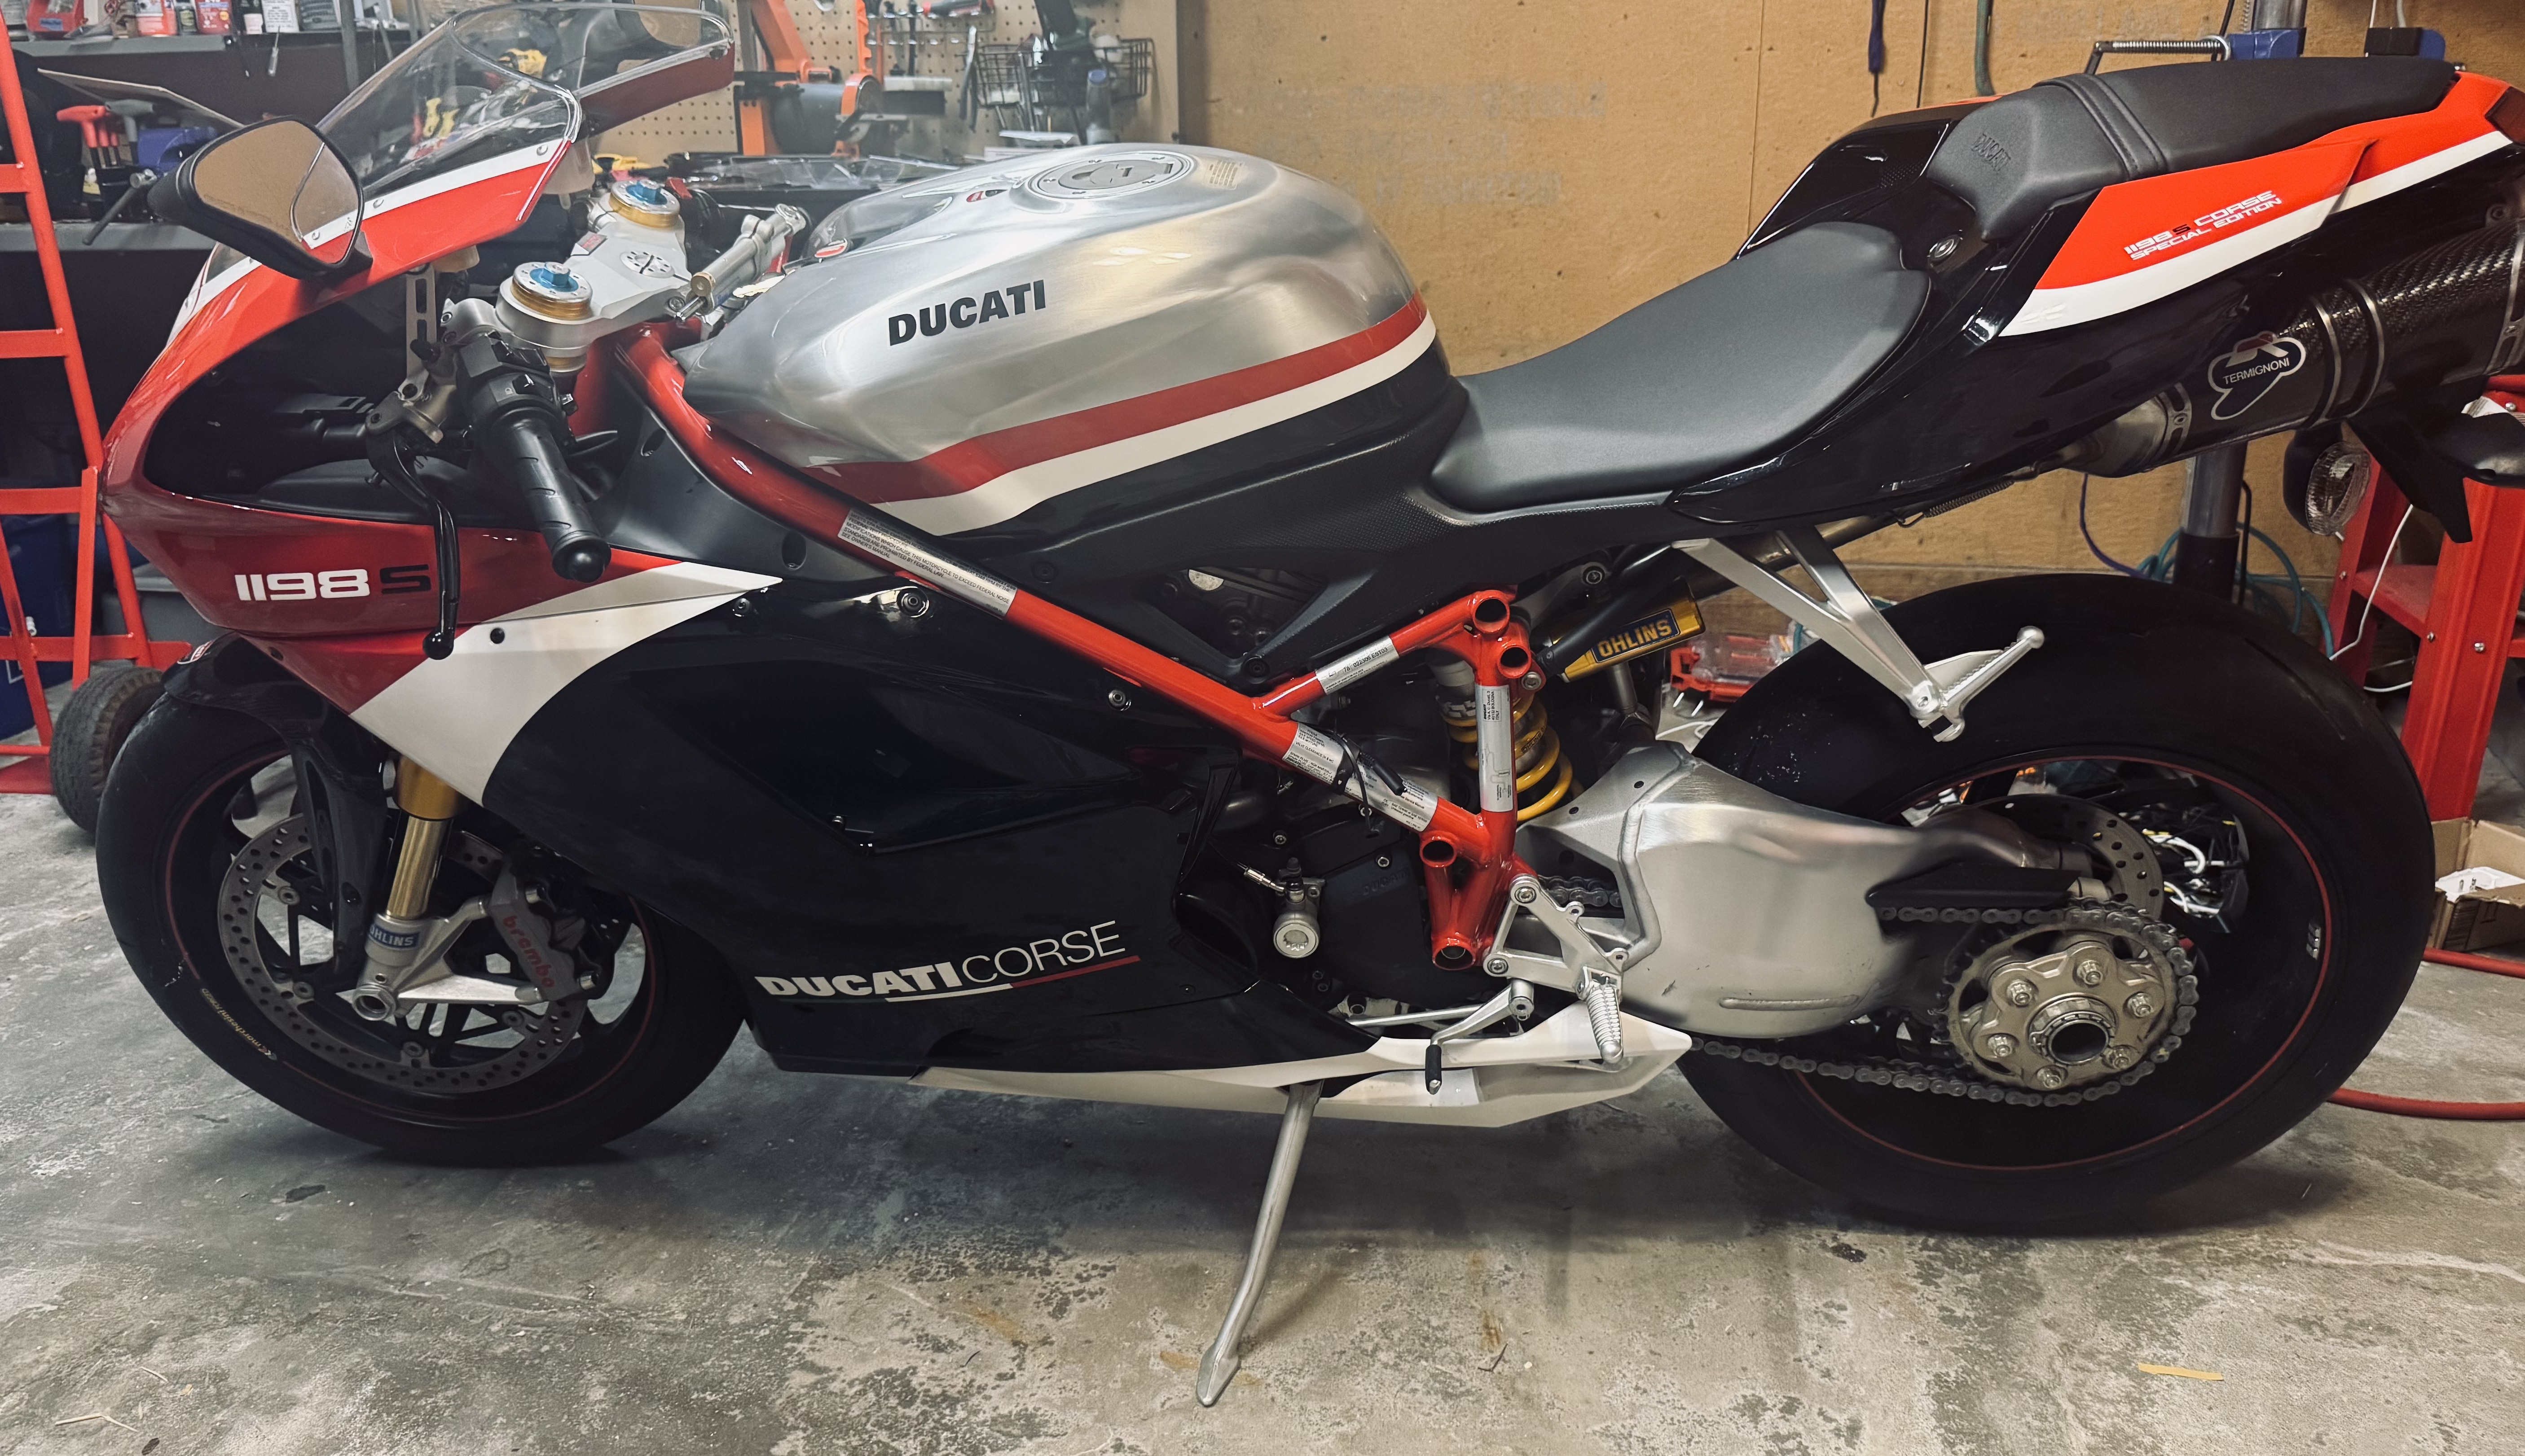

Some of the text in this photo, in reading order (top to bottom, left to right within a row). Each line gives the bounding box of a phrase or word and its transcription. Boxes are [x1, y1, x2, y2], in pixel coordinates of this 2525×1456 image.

[1971, 133, 2011, 171] DUCATI
[2124, 190, 2277, 254] 1198 S CORSE
[2130, 197, 2283, 261] SPECIAL EDITION
[889, 279, 1046, 346] DUCATI
[2223, 357, 2290, 385] TERMIGNONI
[843, 526, 871, 543] STANDARDS
[880, 544, 907, 560] PROHIBITED
[913, 560, 933, 572] FEDERAL
[845, 522, 880, 541] MODIFICATIONS
[880, 539, 896, 548] WHICH
[895, 546, 911, 556] CAUSE
[921, 558, 952, 576] MOTORCYCLE
[959, 576, 977, 588] EXCEED
[976, 584, 996, 597] FEDERAL
[996, 594, 1010, 604] NOISE
[851, 536, 872, 549] OWNER'S
[235, 564, 431, 601] 1198 S
[1371, 646, 1388, 658] EST03
[502, 915, 555, 988] brembo
[754, 920, 1126, 997] DUCATI CORSE
